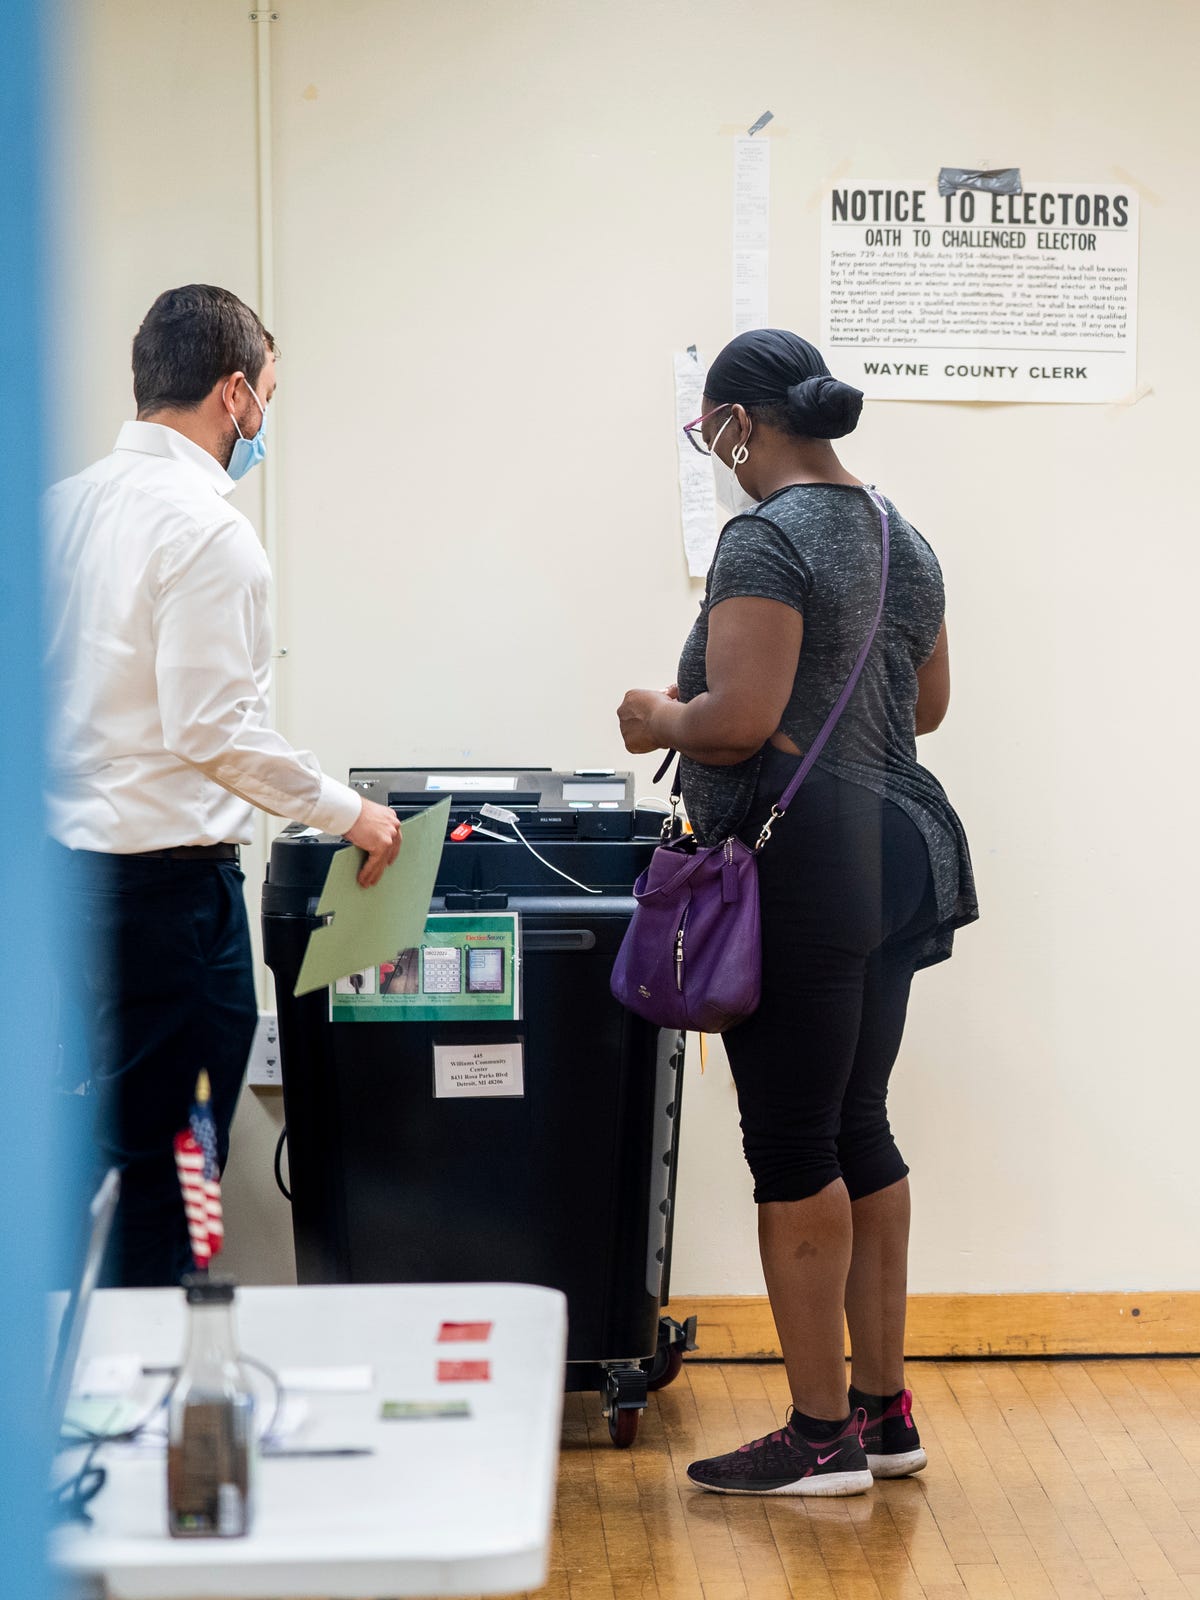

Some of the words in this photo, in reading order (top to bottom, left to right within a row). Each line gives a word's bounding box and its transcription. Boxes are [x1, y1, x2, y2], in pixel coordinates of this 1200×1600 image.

[831, 189, 927, 222] NOTICE
[945, 191, 975, 223] TO
[991, 193, 1129, 227] ELECTORS
[865, 229, 901, 247] OATH
[912, 229, 931, 247] TO
[942, 230, 1026, 249] CHALLENGED
[1037, 232, 1097, 251] ELECTOR
[864, 362, 929, 377] WAYNE
[944, 364, 1019, 379] COUNTY
[1029, 366, 1088, 380] CLERK
